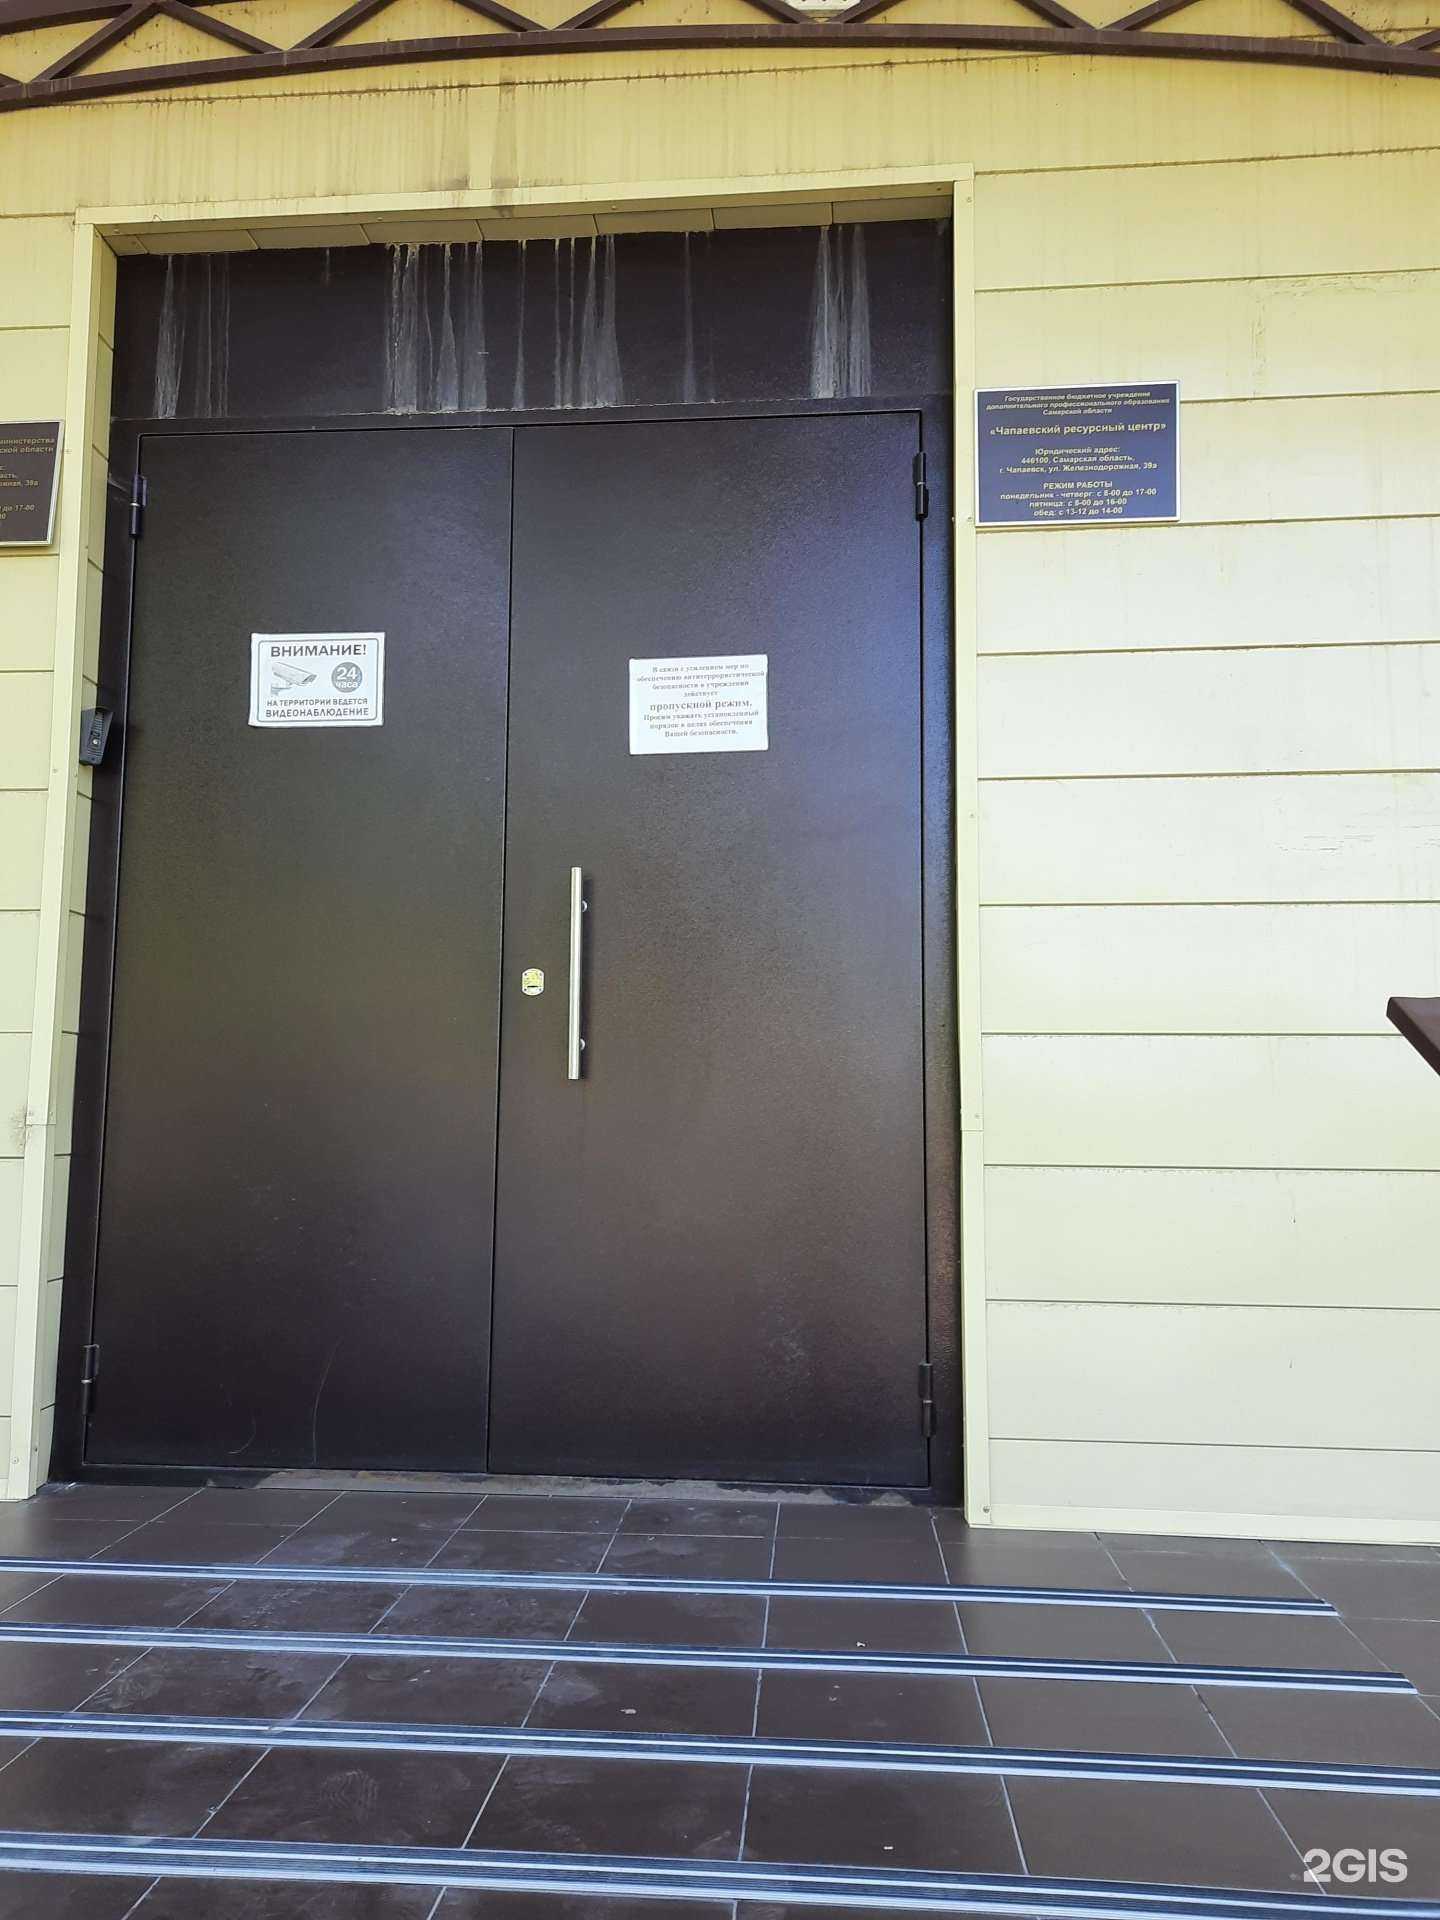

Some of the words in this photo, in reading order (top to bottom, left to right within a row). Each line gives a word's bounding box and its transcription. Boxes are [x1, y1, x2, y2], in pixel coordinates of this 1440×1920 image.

[1004, 394, 1065, 403] Государственное
[1066, 393, 1106, 401] бюджетное
[1123, 398, 1170, 406] образования
[1083, 407, 1112, 415] области
[990, 425, 1061, 437] «Чапаевский
[1064, 423, 1126, 436] ресурсный
[1127, 422, 1167, 433] центр»
[1034, 447, 1092, 456] Юридический
[1094, 446, 1121, 455] адрес:
[1053, 455, 1097, 464] Самарская
[1048, 465, 1061, 474] ул.
[1062, 463, 1142, 472] Железнодорожная,
[1043, 482, 1074, 490] РЕЖИМ
[1076, 480, 1113, 489] РАБОТЫ
[1000, 492, 1054, 501] понедельник
[1136, 488, 1157, 496] 17-00
[1092, 499, 1104, 507] до
[1088, 508, 1099, 516] до
[1101, 507, 1123, 515] 14-00
[271, 644, 367, 658] ВНИМАНИЕ!
[336, 667, 358, 680] 24
[267, 699, 278, 707] НА
[279, 699, 332, 707] ТЕРРИТОРИИ
[333, 698, 368, 706] ВЕДЕТСЯ
[650, 701, 713, 712] пропускной
[265, 707, 369, 718] ВИДЕОНАБЛЮДЕНИЕ
[643, 713, 671, 722] Просим
[649, 721, 679, 730] порядок
[686, 721, 708, 729] целях
[664, 729, 689, 738] Вашей
